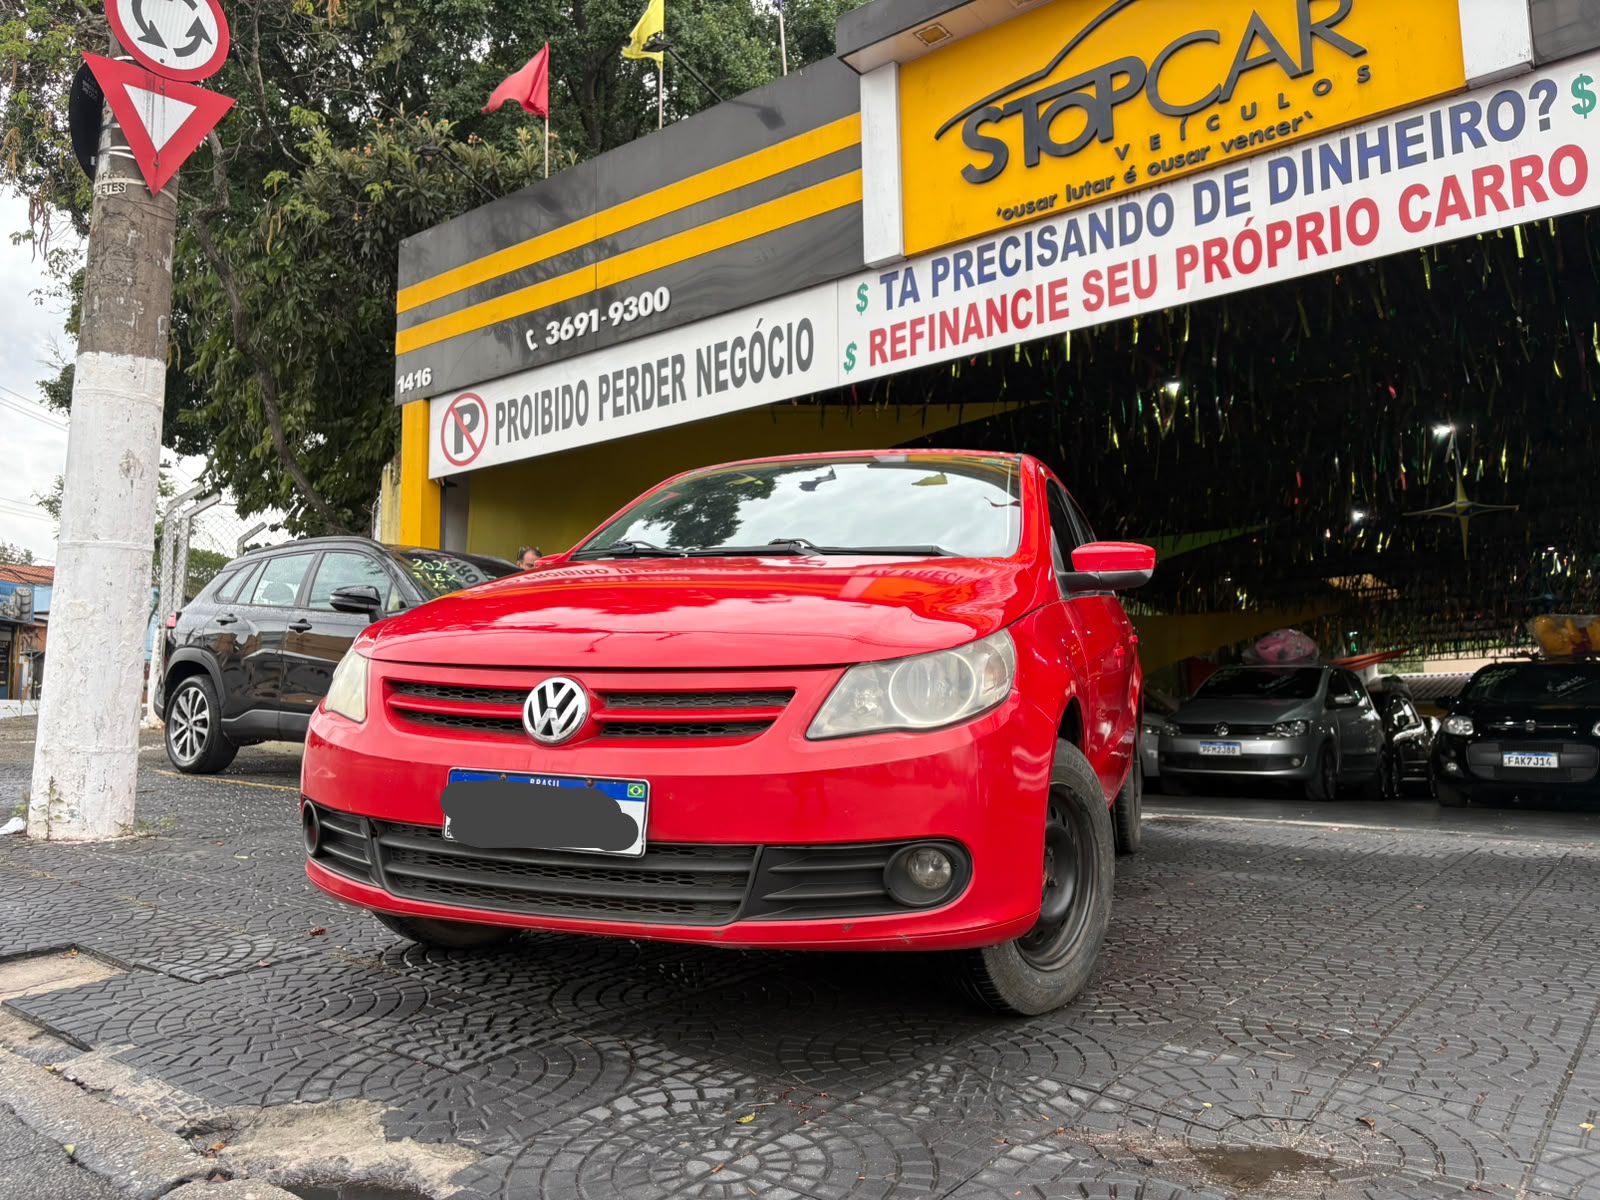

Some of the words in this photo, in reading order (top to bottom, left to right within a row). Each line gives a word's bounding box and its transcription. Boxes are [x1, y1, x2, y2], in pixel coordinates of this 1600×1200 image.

[880, 266, 921, 311] TA
[931, 192, 1174, 298] PRECISANDO
[1193, 168, 1251, 226] DE
[1268, 79, 1558, 206] DINHEIRO?
[1065, 173, 1115, 202] lutar
[1123, 165, 1137, 184] é
[1147, 144, 1211, 176] ousar
[869, 277, 1070, 367] REFINANCIE
[1082, 254, 1158, 312] SEU
[1176, 197, 1380, 291] PRÓPRIO
[1398, 144, 1589, 234] CARRO
[545, 285, 671, 345] 3691-9300
[397, 367, 432, 393] 1416
[495, 379, 589, 446] PROIBIDO
[598, 353, 686, 421] PERDER
[695, 317, 815, 398] NEGÓCIO
